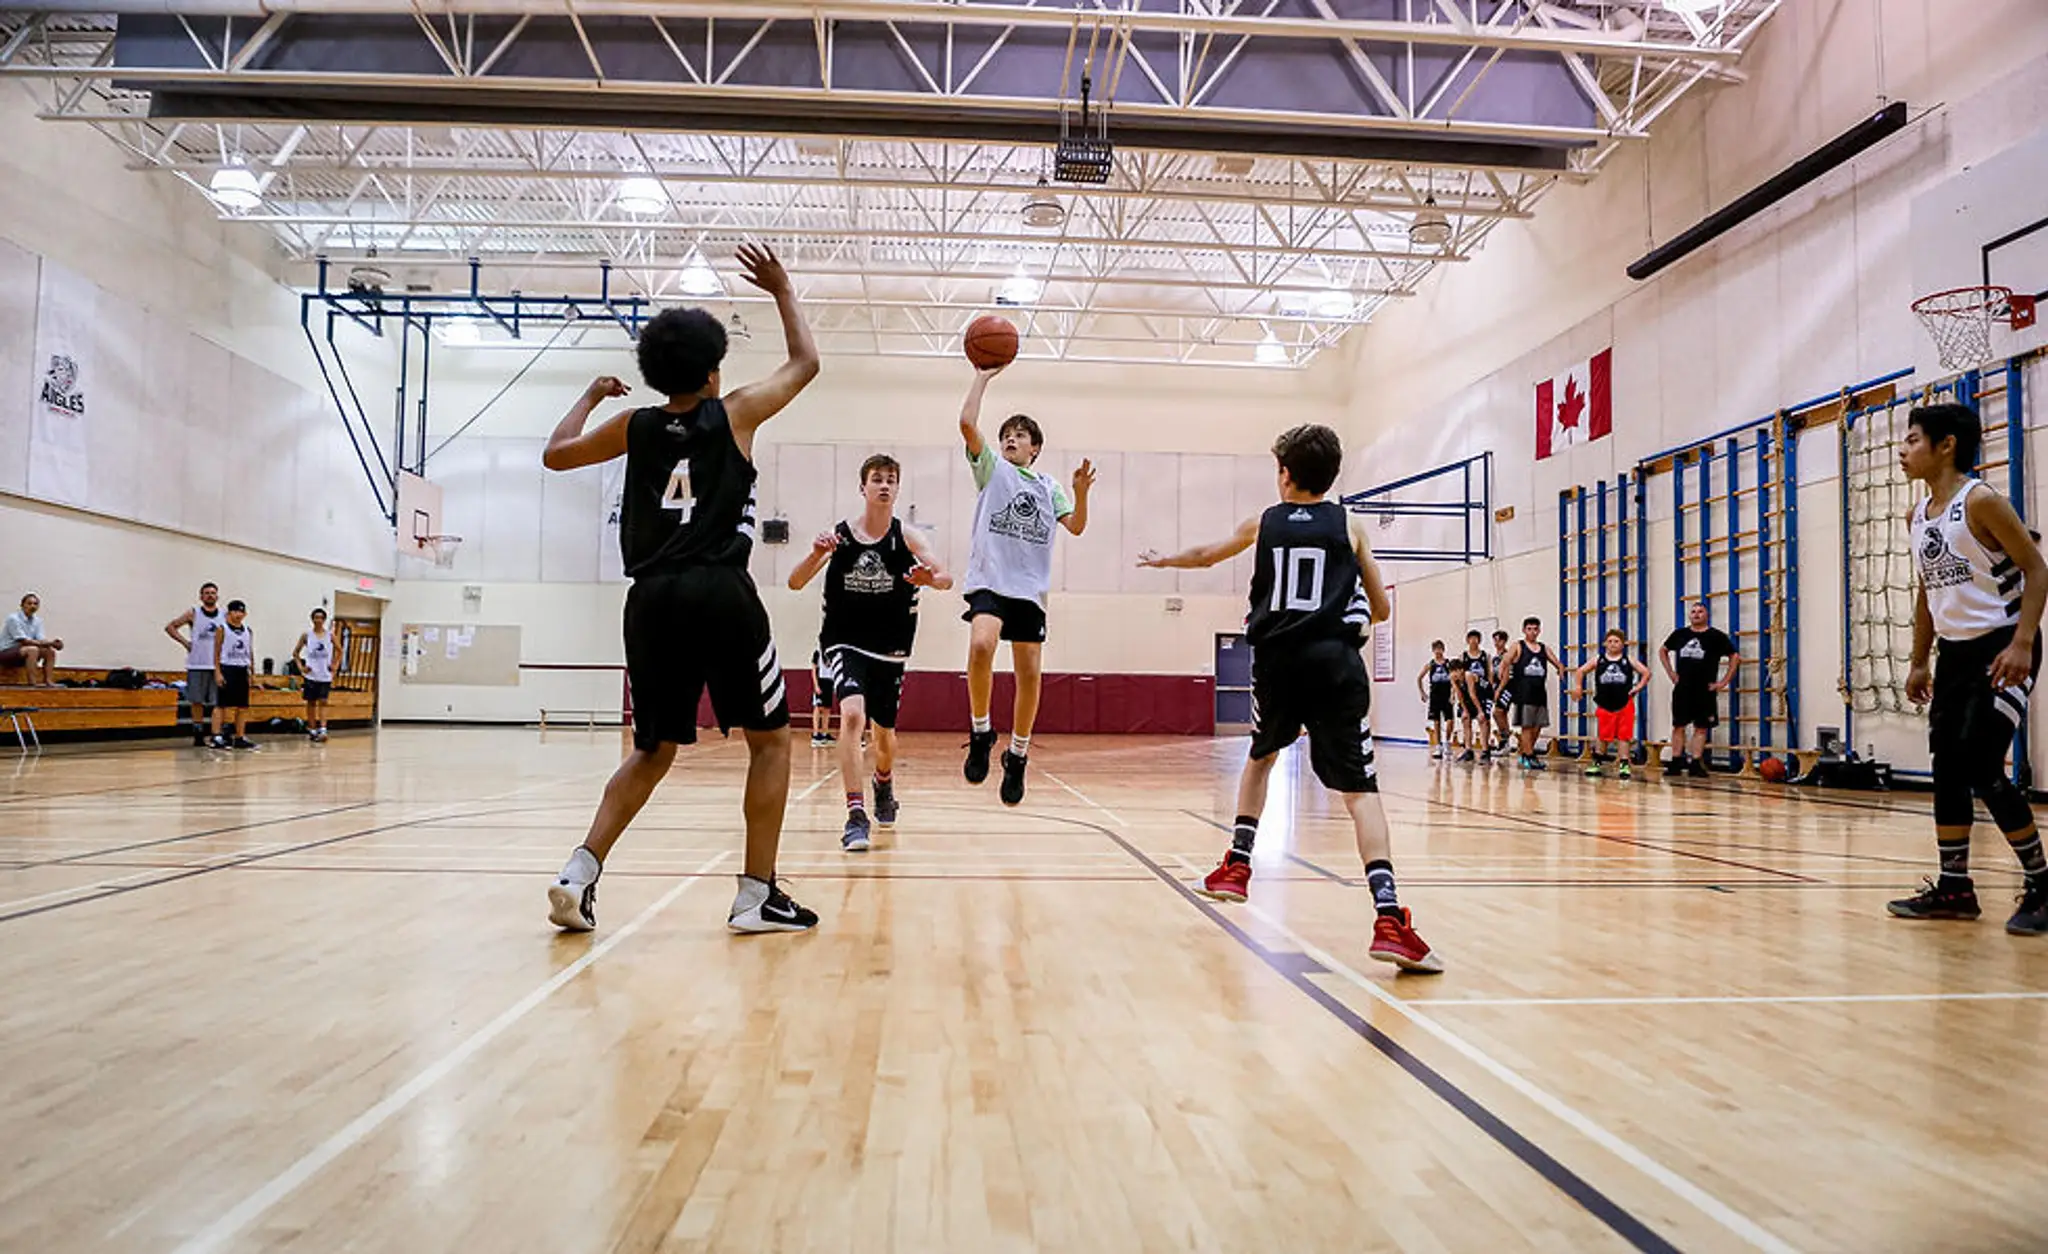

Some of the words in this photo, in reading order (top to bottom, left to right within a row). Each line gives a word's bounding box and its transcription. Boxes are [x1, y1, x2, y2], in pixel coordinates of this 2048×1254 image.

[41, 382, 84, 413] AIGLES
[660, 457, 697, 525] 4
[1950, 501, 1962, 521] 15
[1270, 547, 1326, 611] 10
